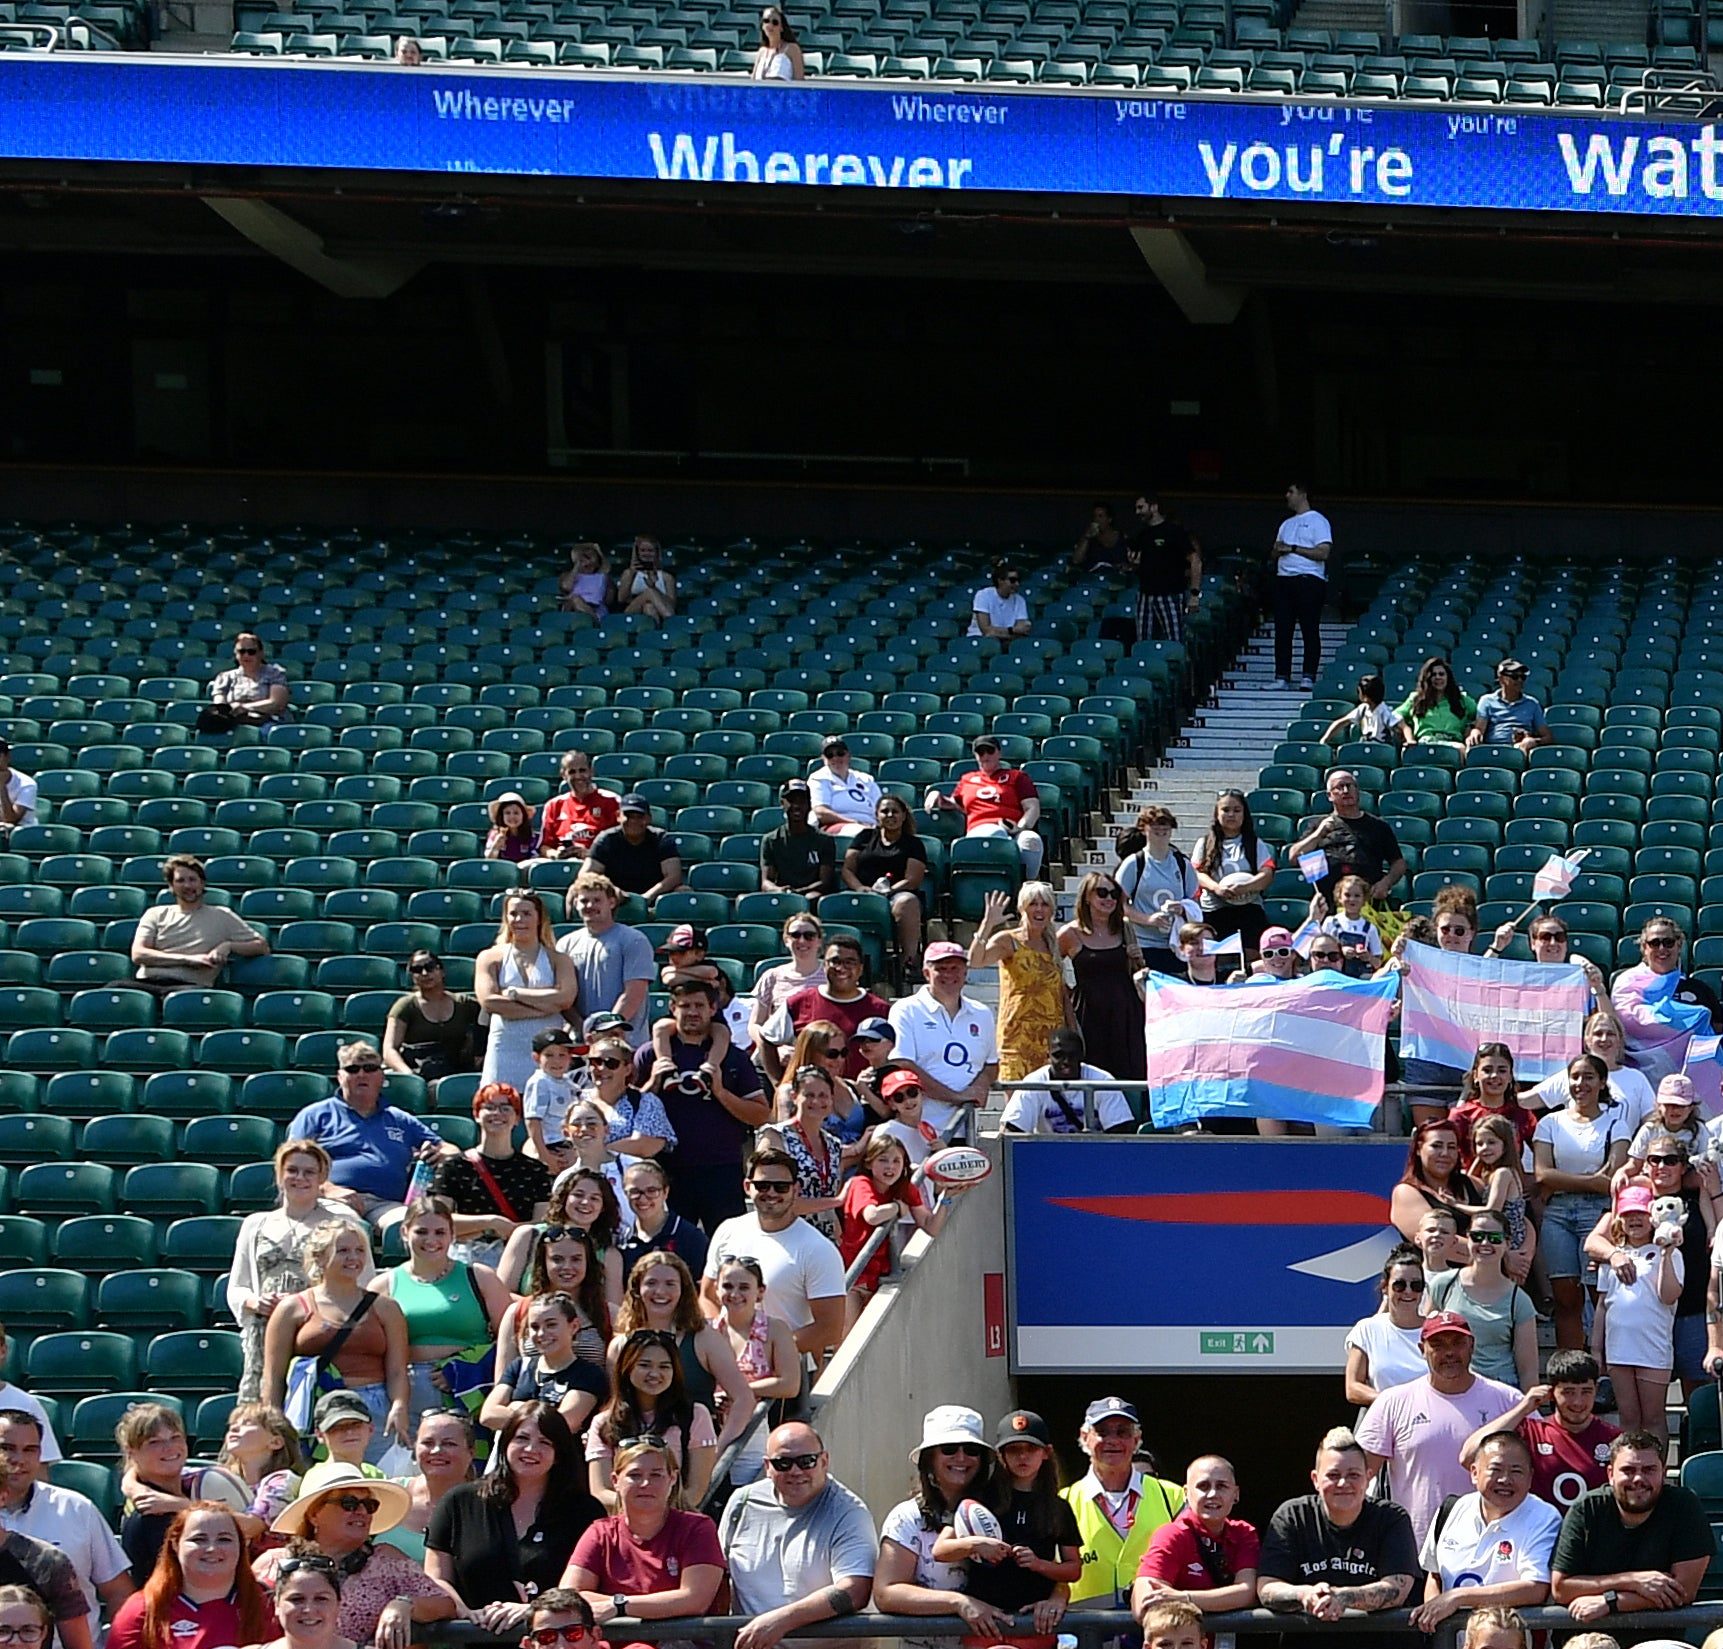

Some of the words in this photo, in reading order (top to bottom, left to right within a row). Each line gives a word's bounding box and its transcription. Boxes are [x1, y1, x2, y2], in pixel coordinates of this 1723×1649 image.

[434, 90, 574, 126] Wherever
[893, 94, 1007, 127] Wherever
[1116, 96, 1186, 124] you're
[649, 131, 972, 190] Wherever
[1201, 134, 1414, 197] you're
[1176, 739, 1187, 748] 30
[976, 785, 1001, 802] O2
[1091, 854, 1104, 863] 25
[942, 1043, 973, 1073] O2
[938, 1159, 988, 1174] GILBERT
[1299, 1560, 1327, 1577] Los
